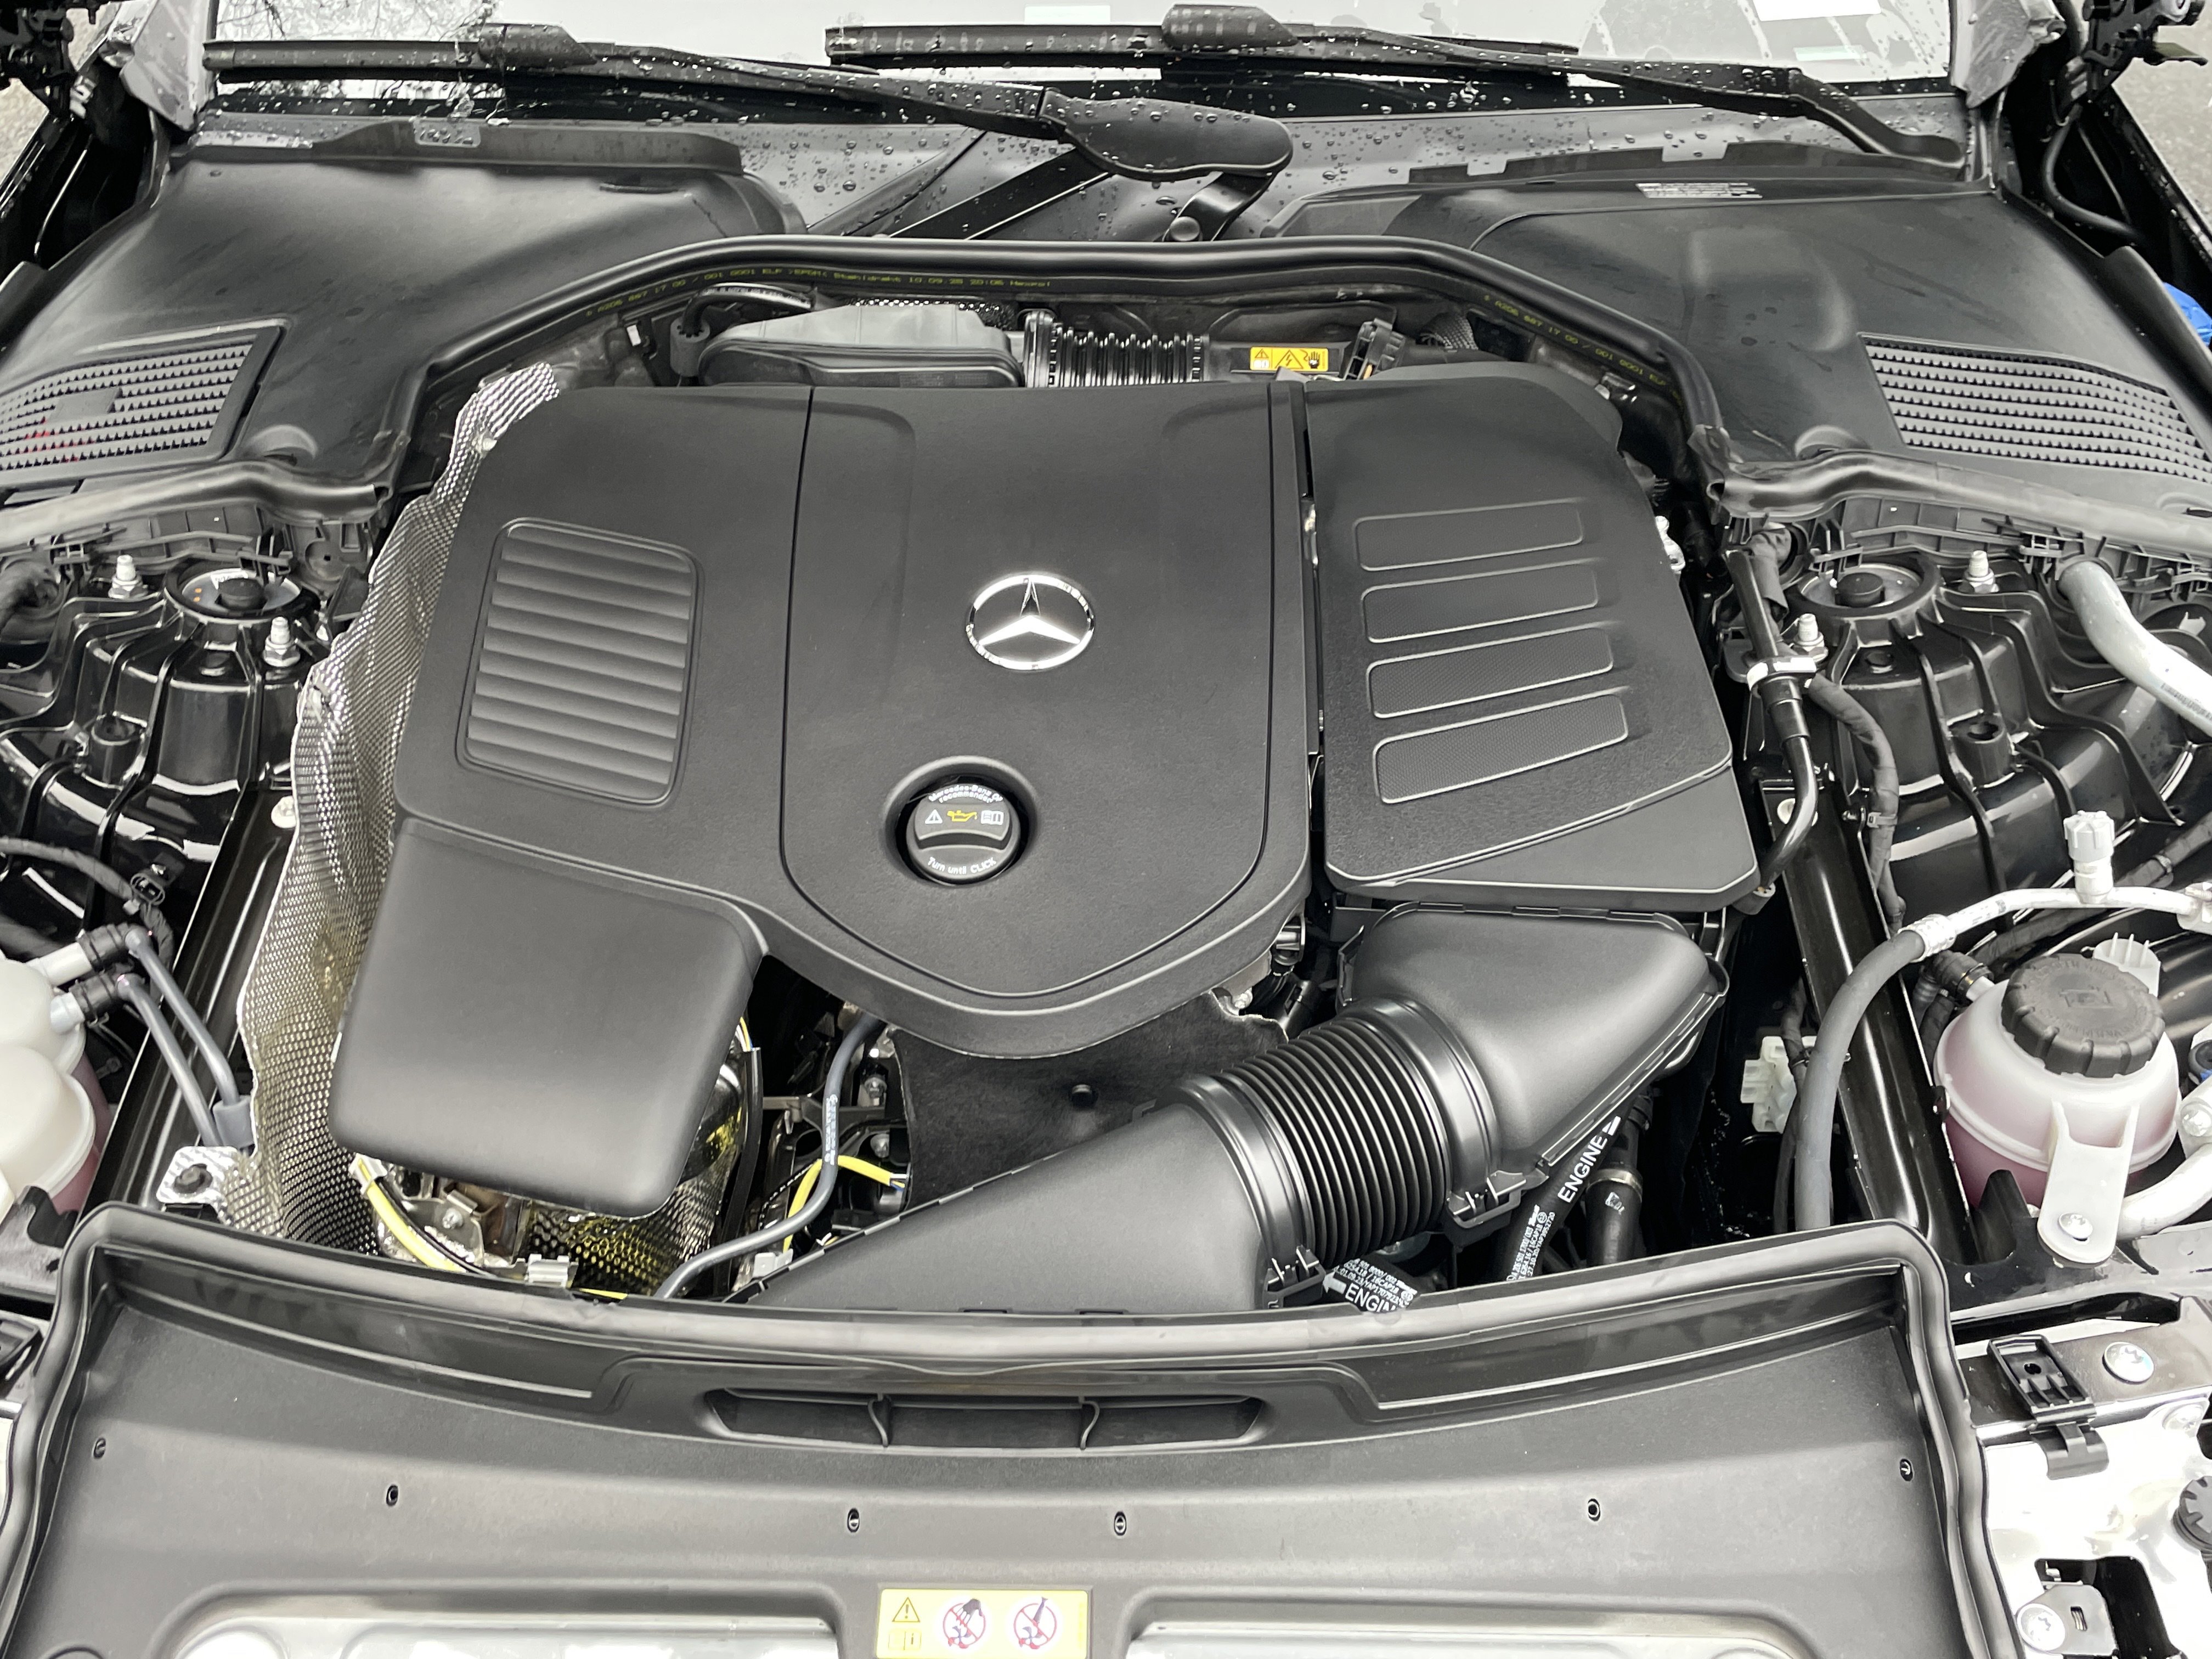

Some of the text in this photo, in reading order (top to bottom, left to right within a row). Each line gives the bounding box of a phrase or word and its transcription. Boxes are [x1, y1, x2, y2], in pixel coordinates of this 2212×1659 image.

[928, 856, 997, 874] Turn until CLICK
[1558, 1135, 1607, 1204] ENGINE
[1345, 1283, 1396, 1312] ENGI
